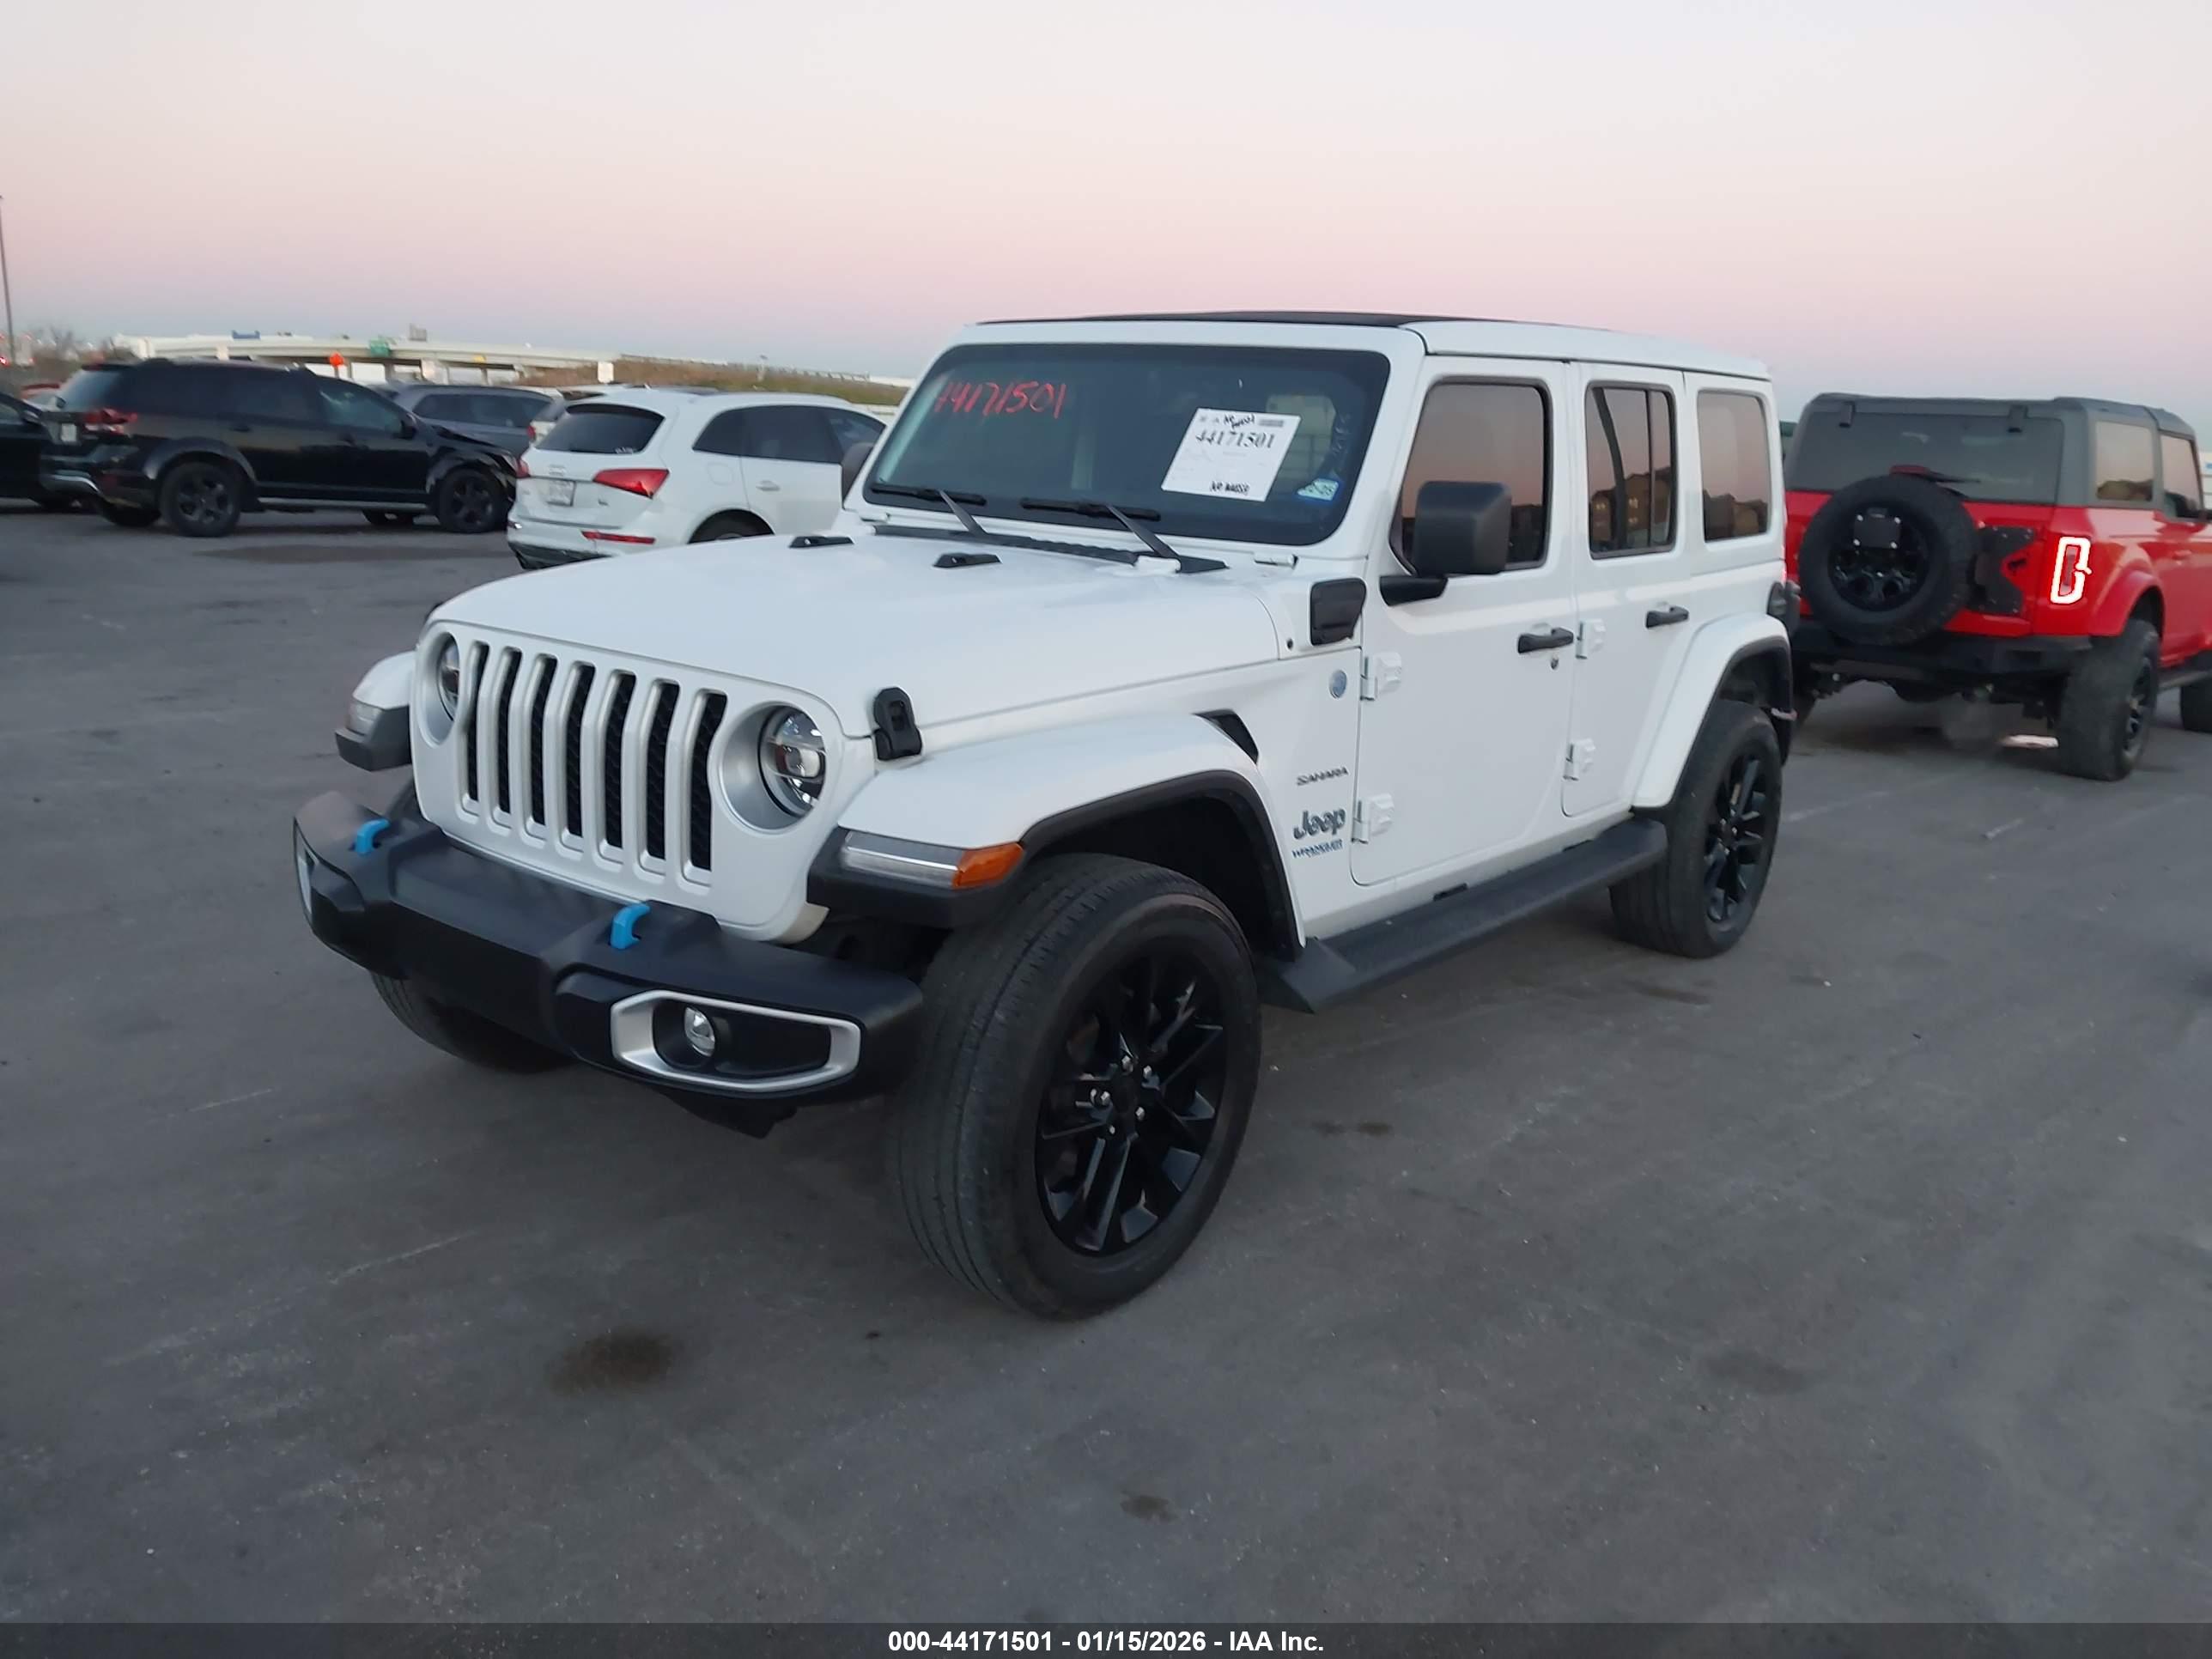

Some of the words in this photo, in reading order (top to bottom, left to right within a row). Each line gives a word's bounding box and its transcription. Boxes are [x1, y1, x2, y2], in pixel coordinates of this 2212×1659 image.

[1195, 429, 1276, 449] 44171501
[1296, 767, 1349, 786] SAHARA
[1292, 808, 1346, 840] Jeep
